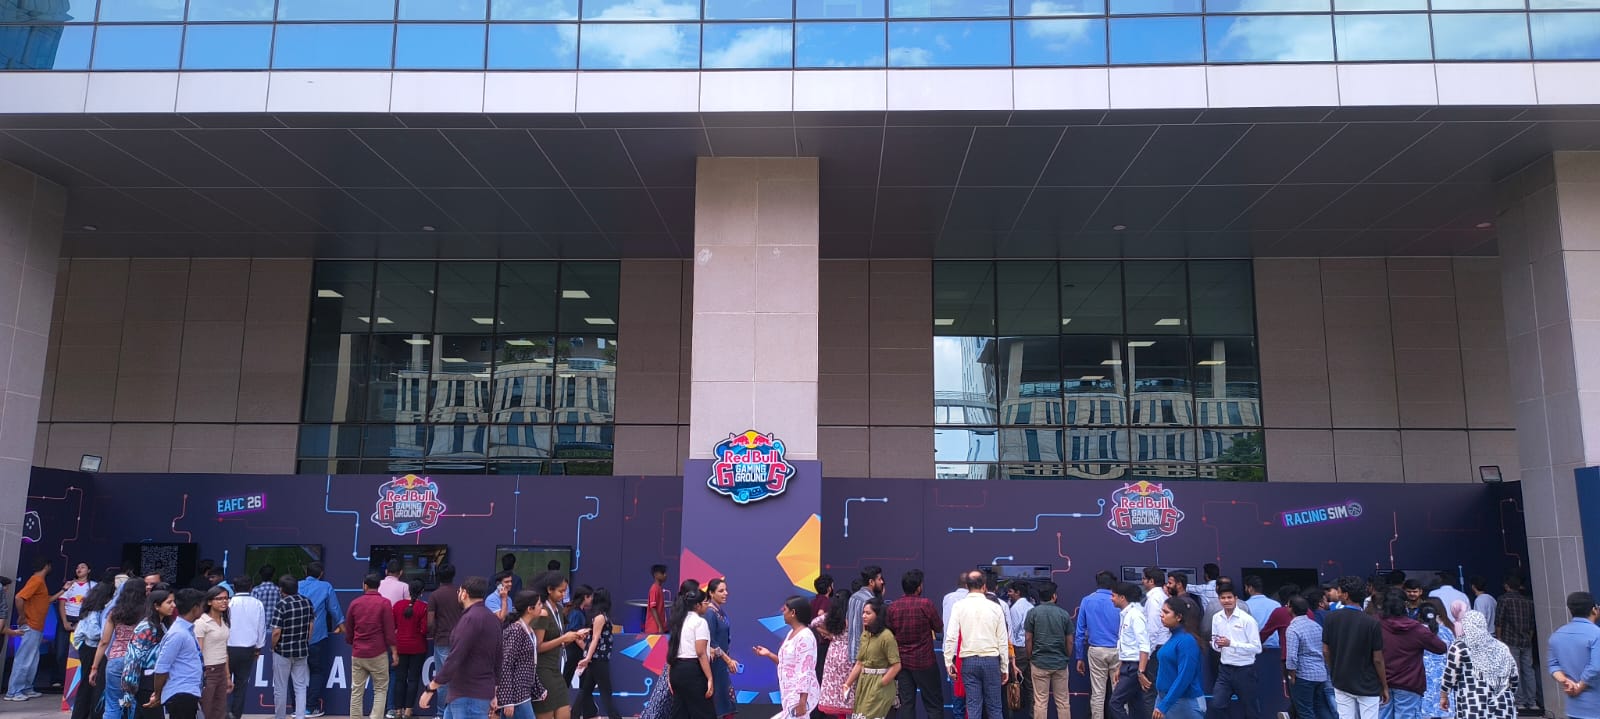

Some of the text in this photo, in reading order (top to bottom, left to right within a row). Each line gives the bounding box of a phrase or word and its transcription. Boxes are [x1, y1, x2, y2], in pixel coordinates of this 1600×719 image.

[724, 450, 778, 463] Red Bull
[735, 464, 767, 473] GAMING
[735, 473, 768, 482] GROUND
[386, 490, 433, 502] Red Bull
[247, 495, 262, 509] 26
[395, 502, 422, 510] GAMING
[1121, 497, 1169, 509] Red Bull
[395, 509, 422, 518] GROUND
[1131, 509, 1159, 517] GAMING
[1285, 505, 1348, 527] RACING SIM
[1131, 516, 1160, 525] GROUND
